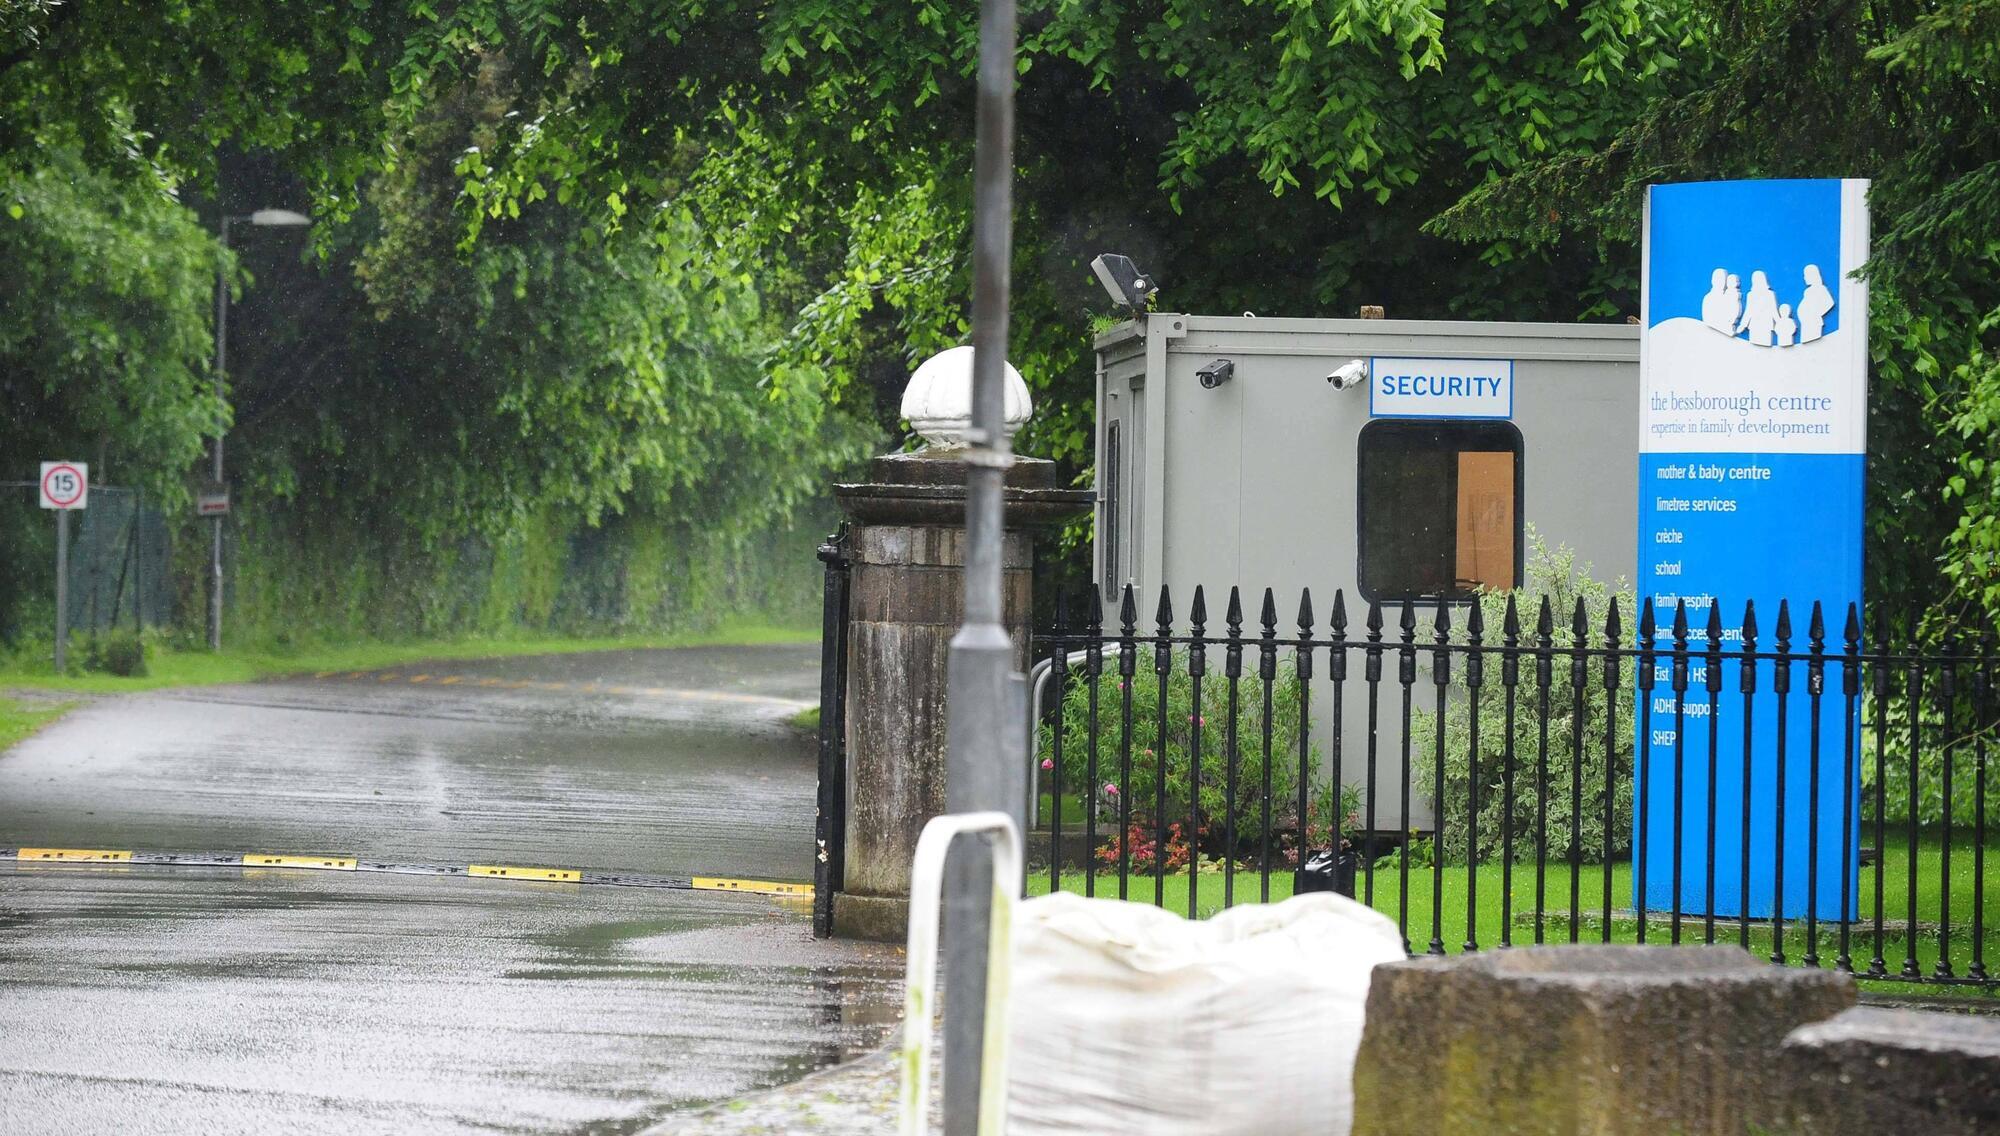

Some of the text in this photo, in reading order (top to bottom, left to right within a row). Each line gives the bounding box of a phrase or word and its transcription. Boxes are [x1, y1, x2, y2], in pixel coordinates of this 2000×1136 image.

[1381, 375, 1502, 397] SECURITY
[1651, 390, 1832, 416] the bessborough centre
[1651, 418, 1830, 438] expertise in family development
[1657, 464, 1771, 482] mother & baby centre
[54, 474, 74, 492] 15
[1656, 497, 1737, 512] limetree services
[1655, 528, 1683, 544] crèche
[1655, 560, 1681, 576] school
[1655, 592, 1679, 611] family
[1655, 624, 1677, 640] famil
[1652, 730, 1677, 746] SHEP
